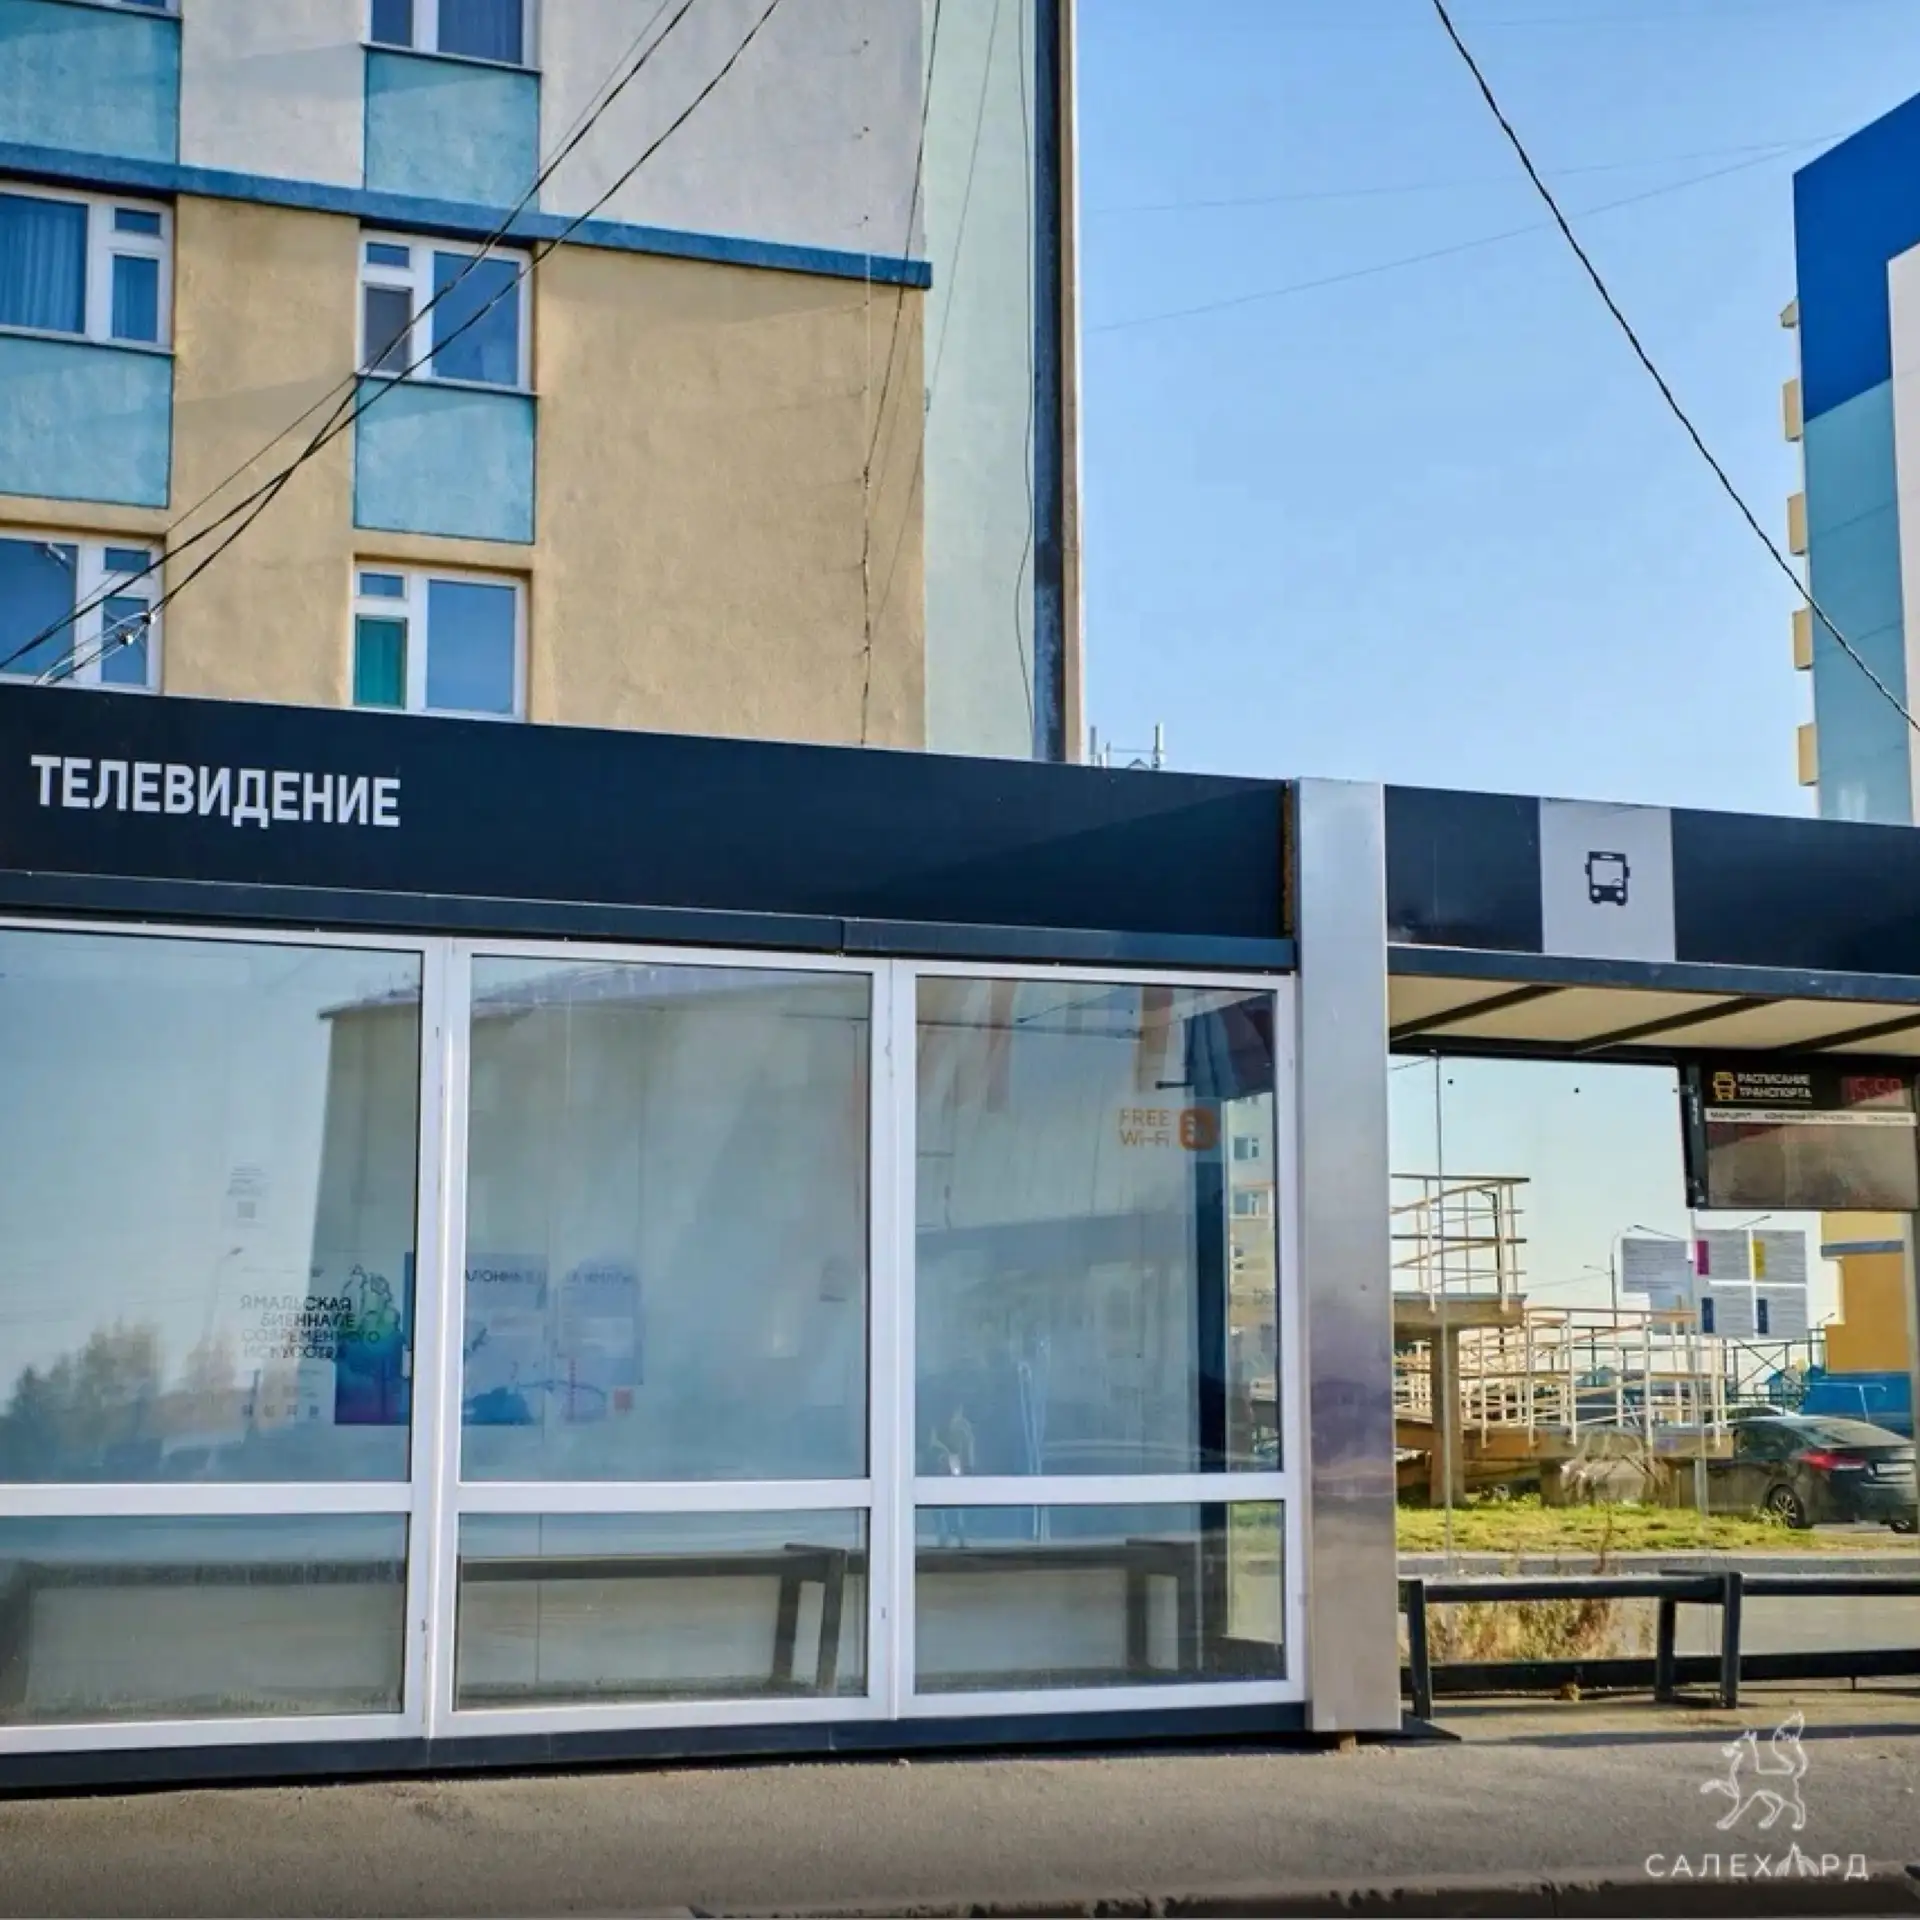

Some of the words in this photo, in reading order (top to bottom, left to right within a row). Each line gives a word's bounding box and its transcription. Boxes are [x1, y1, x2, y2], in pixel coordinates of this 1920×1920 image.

[31, 754, 401, 829] ТЕЛЕВИДЕНИЕ
[1119, 1108, 1171, 1126] FREE
[1119, 1130, 1170, 1148] Wi-Fi
[240, 1295, 352, 1311] ЯМАЛЬСКАЯ
[260, 1312, 355, 1328] БИЕННАЛЕ
